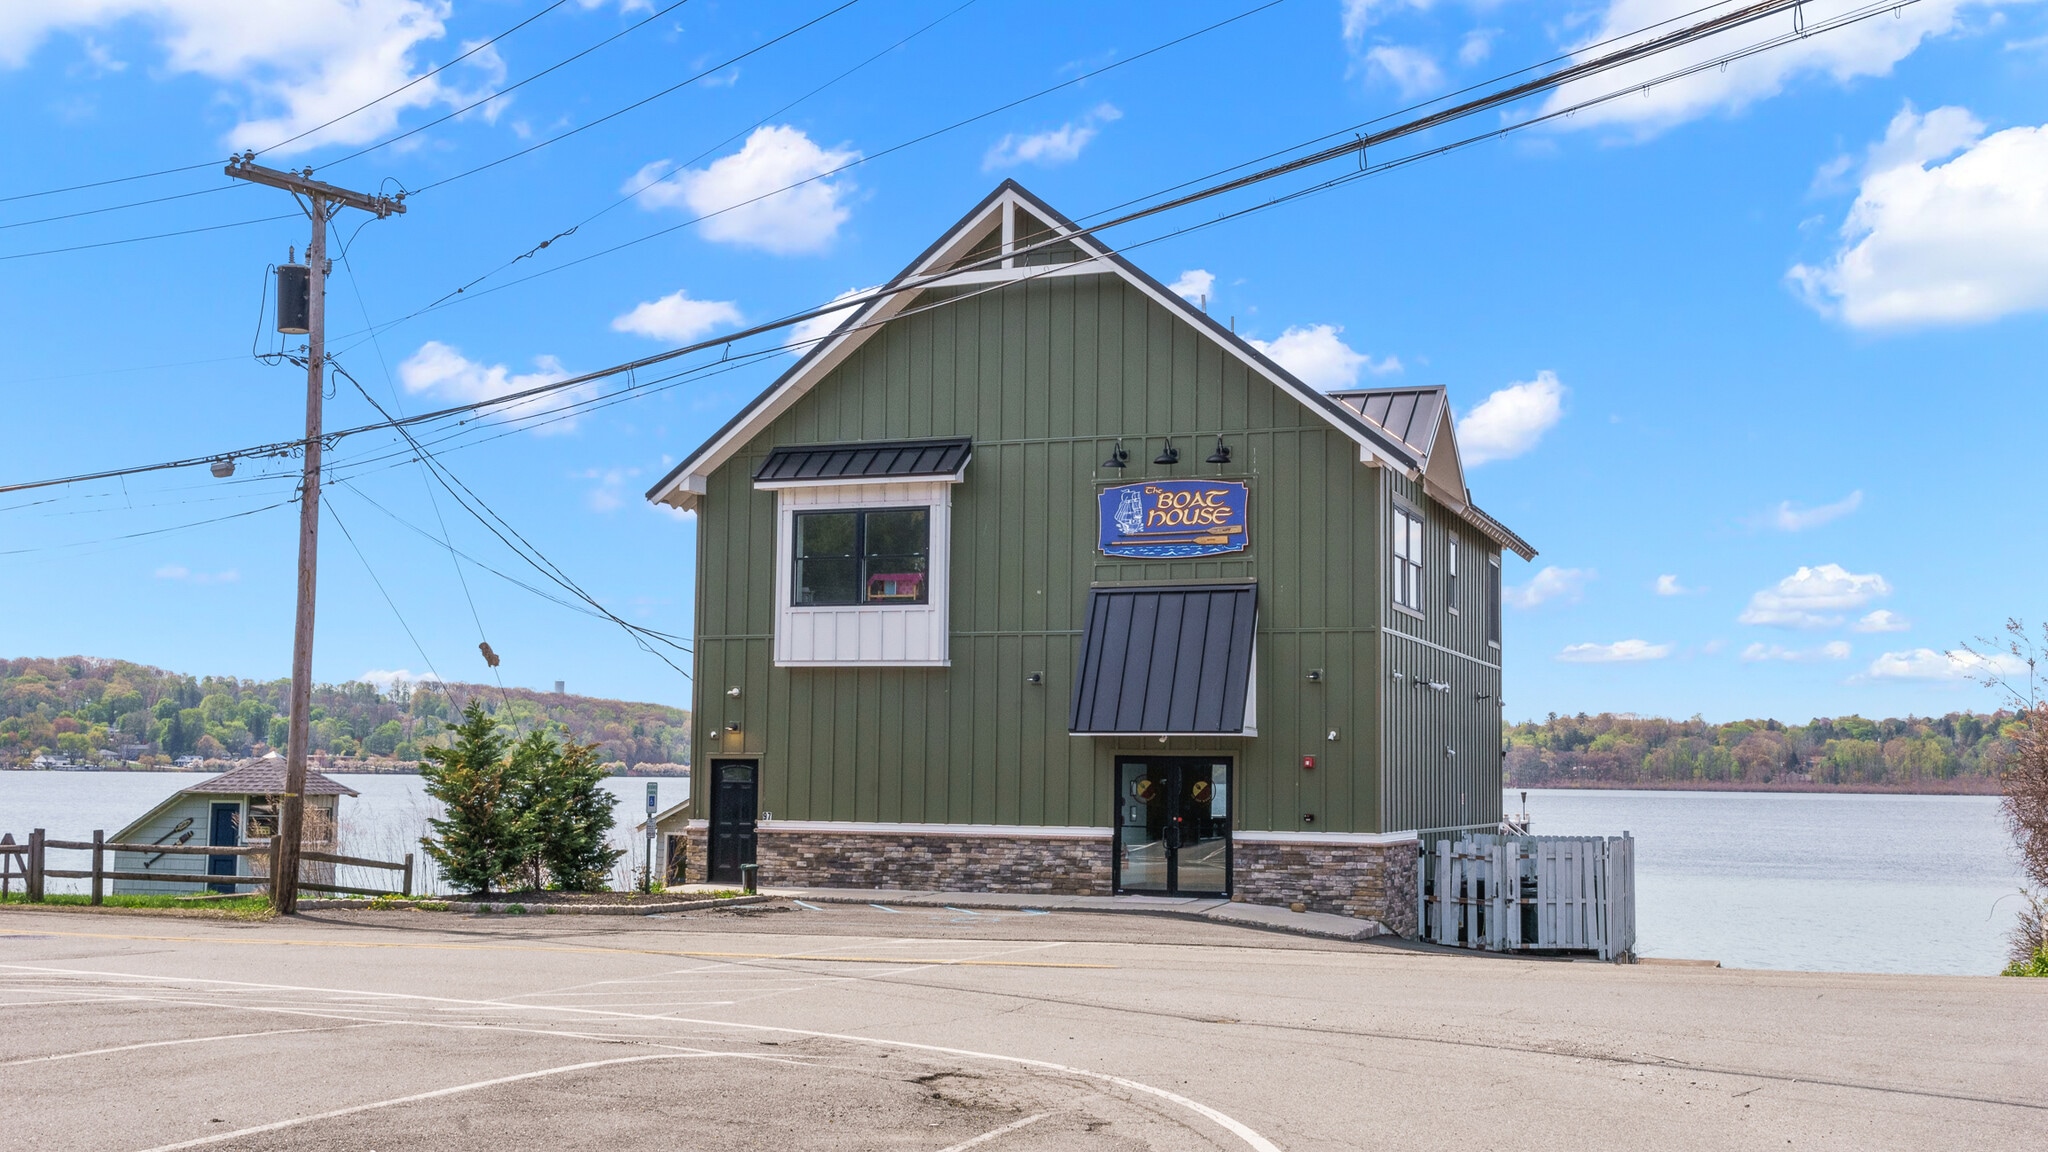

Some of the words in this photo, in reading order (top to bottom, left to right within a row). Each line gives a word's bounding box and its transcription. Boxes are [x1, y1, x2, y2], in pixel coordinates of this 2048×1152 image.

[1145, 486, 1163, 494] The
[1157, 490, 1229, 509] BOAT
[763, 811, 771, 820] 97
